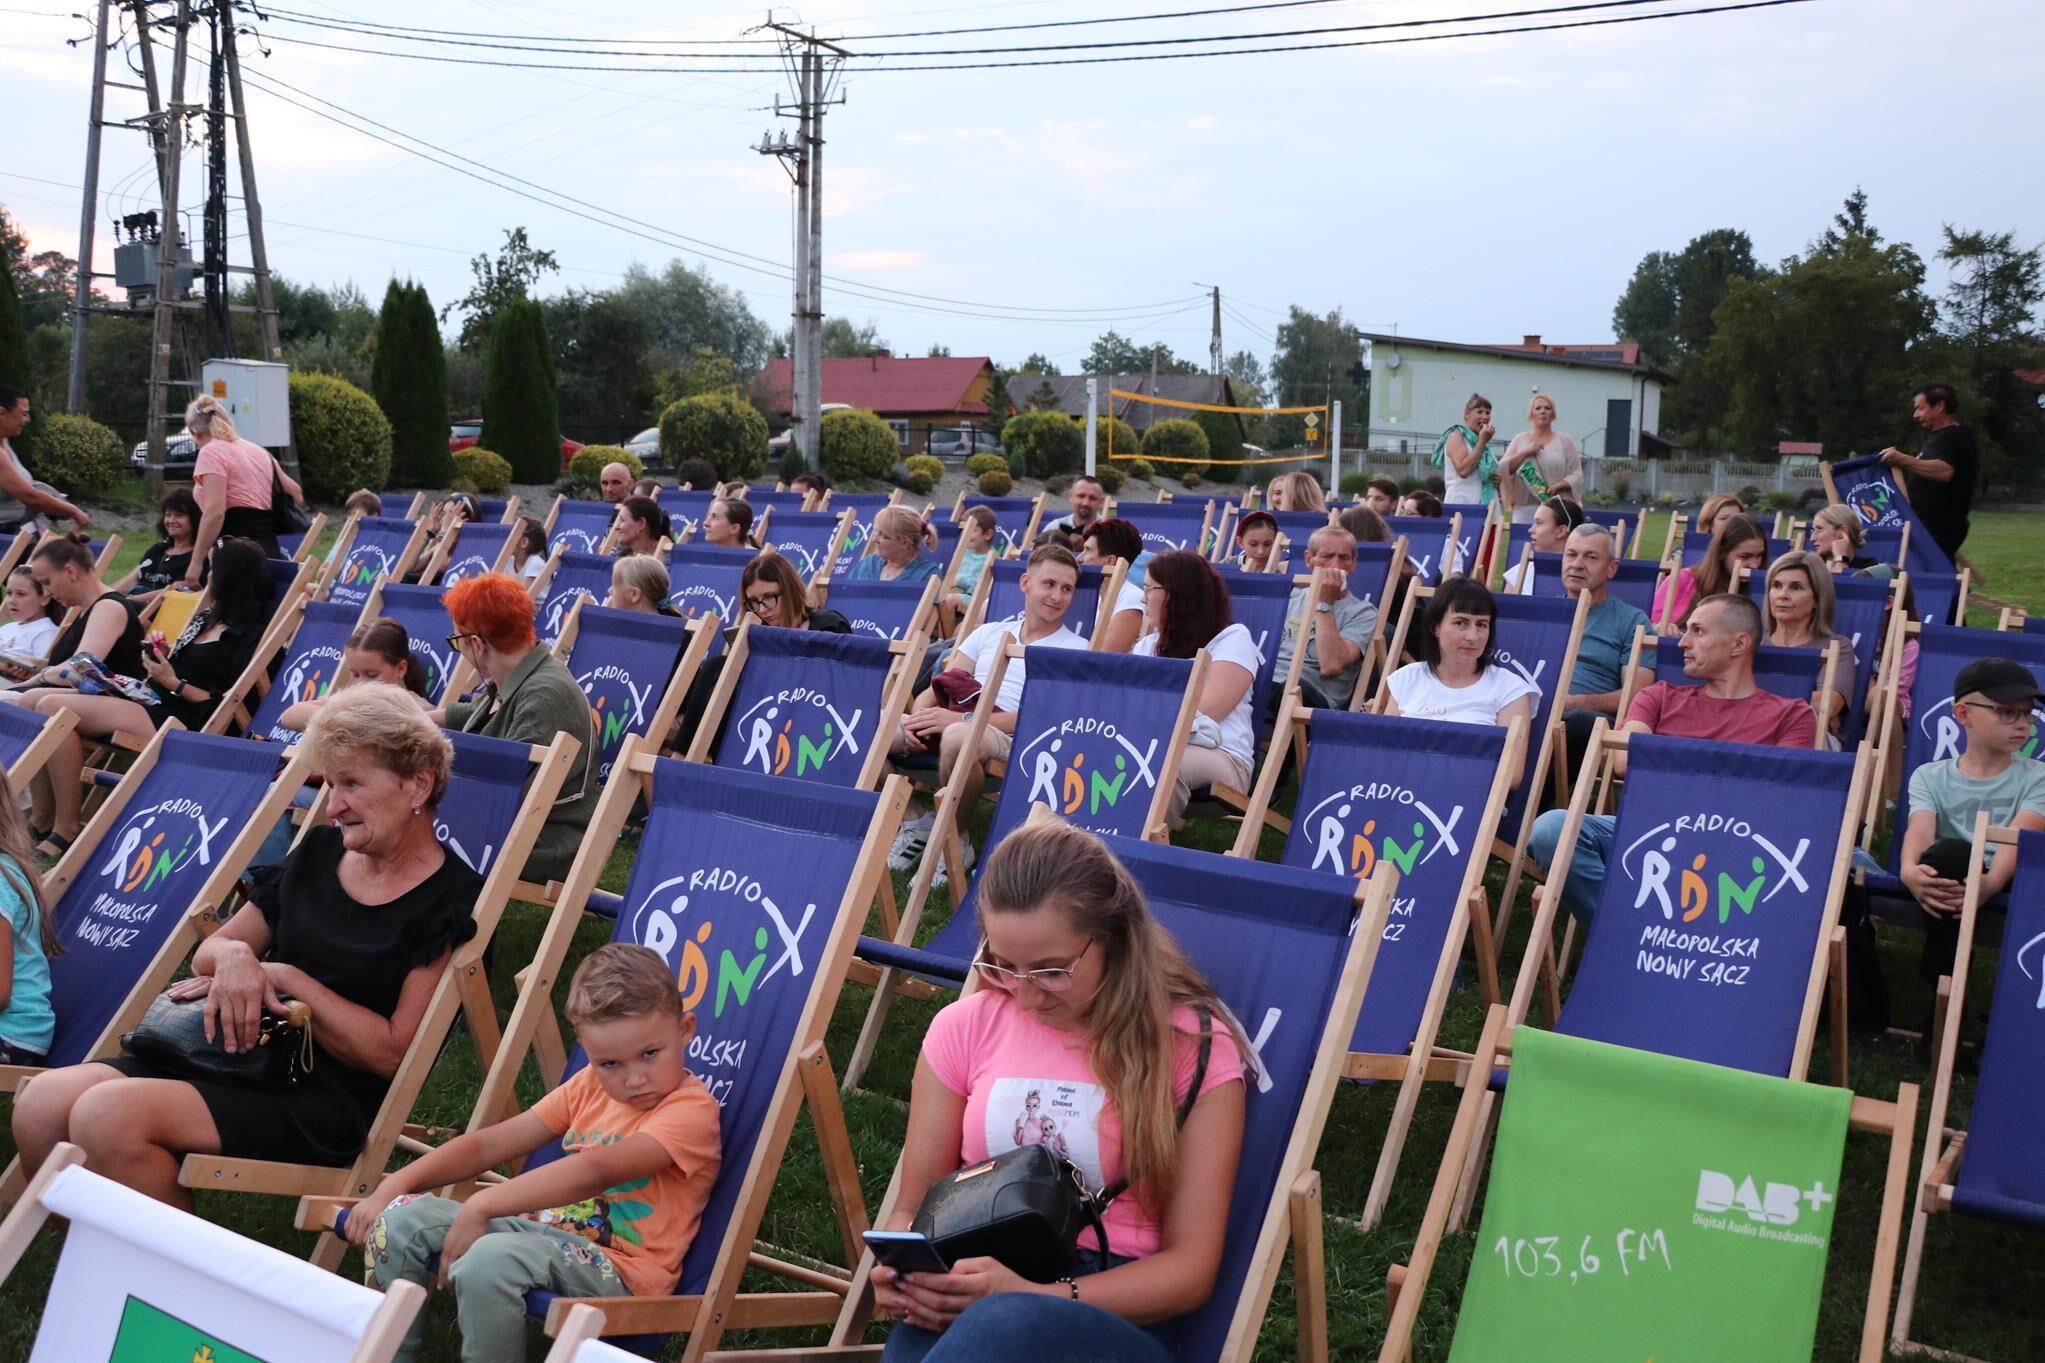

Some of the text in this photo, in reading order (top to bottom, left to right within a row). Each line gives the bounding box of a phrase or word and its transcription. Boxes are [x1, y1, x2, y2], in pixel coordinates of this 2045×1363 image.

[778, 542, 803, 553] RADIO
[1141, 532, 1166, 543] ADIO
[685, 585, 716, 598] RADIO
[850, 619, 876, 631] ADIO
[310, 645, 343, 661] RADIO
[408, 637, 431, 655] ADIO
[593, 664, 630, 685] RADIO
[777, 687, 827, 708] RADIO
[269, 725, 298, 744] NOWY
[1060, 717, 1116, 739] RADIO
[1350, 782, 1414, 805] RADIO
[158, 798, 203, 819] RADIO
[1675, 813, 1751, 838] RADIO
[689, 867, 762, 903] RADIO
[76, 915, 115, 947] NOWY
[1640, 925, 1760, 959] MAŁOPOLSKA
[1636, 950, 1696, 980] NOWY
[1692, 1212, 1825, 1249] Digital Audio Broadcasting
[1494, 1227, 1672, 1286] 103,6 FM
